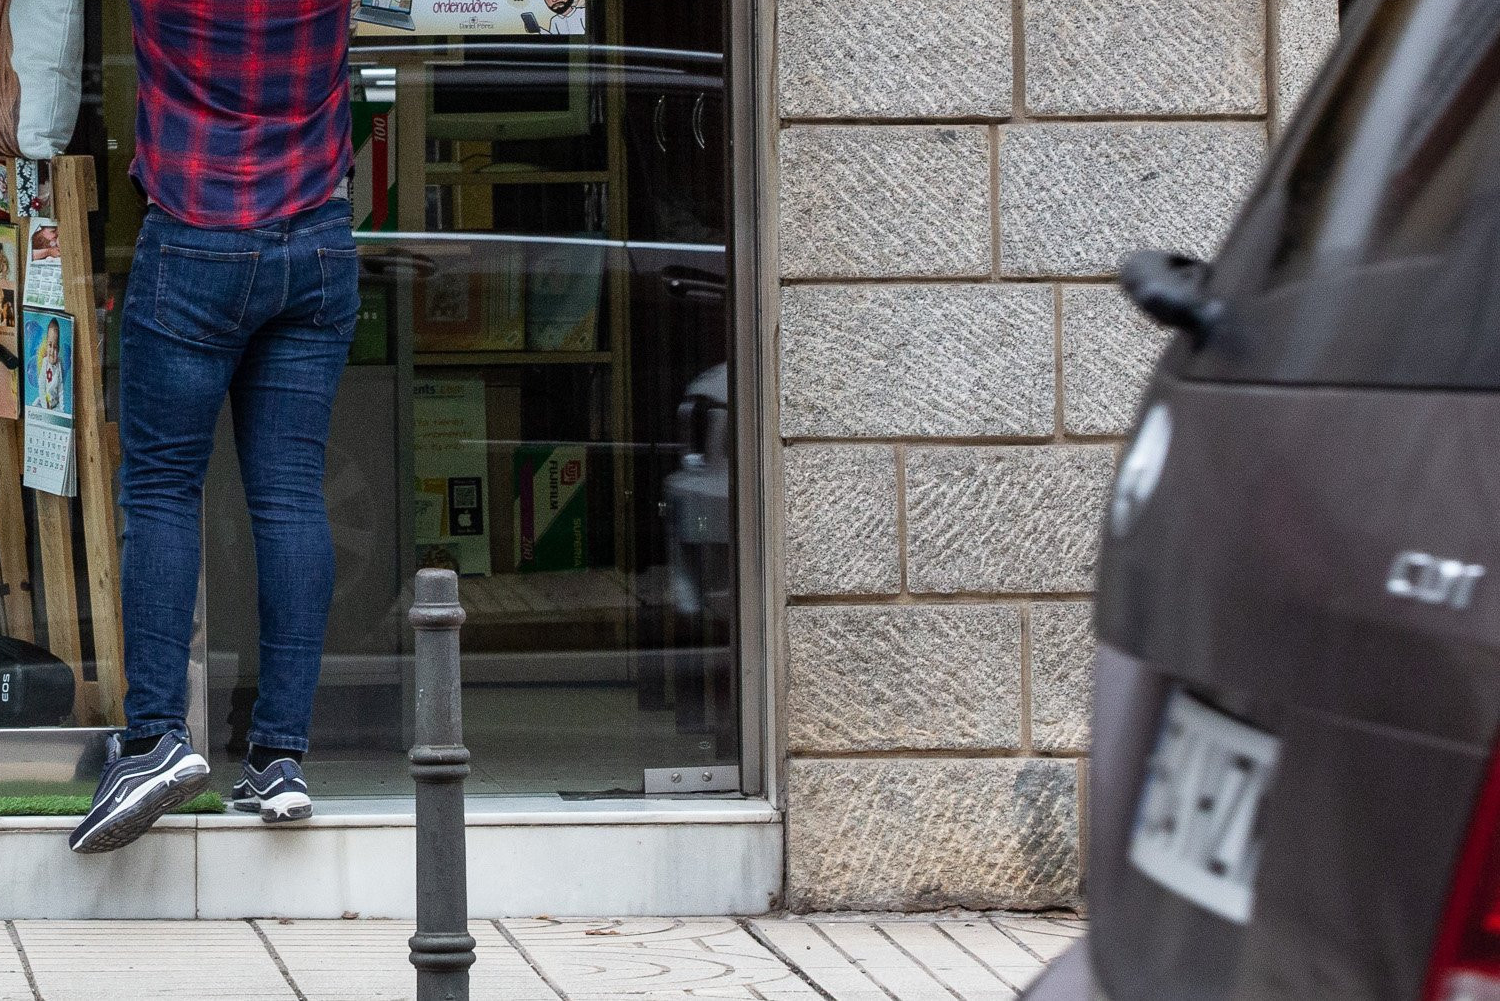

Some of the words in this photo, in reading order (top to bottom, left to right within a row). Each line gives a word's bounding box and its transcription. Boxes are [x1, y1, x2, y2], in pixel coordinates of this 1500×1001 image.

[432, 0, 498, 13] ordenadores
[373, 116, 386, 142] 100
[549, 460, 559, 510] FUJIFILM
[522, 536, 534, 560] 200
[1, 673, 11, 702] EOS
